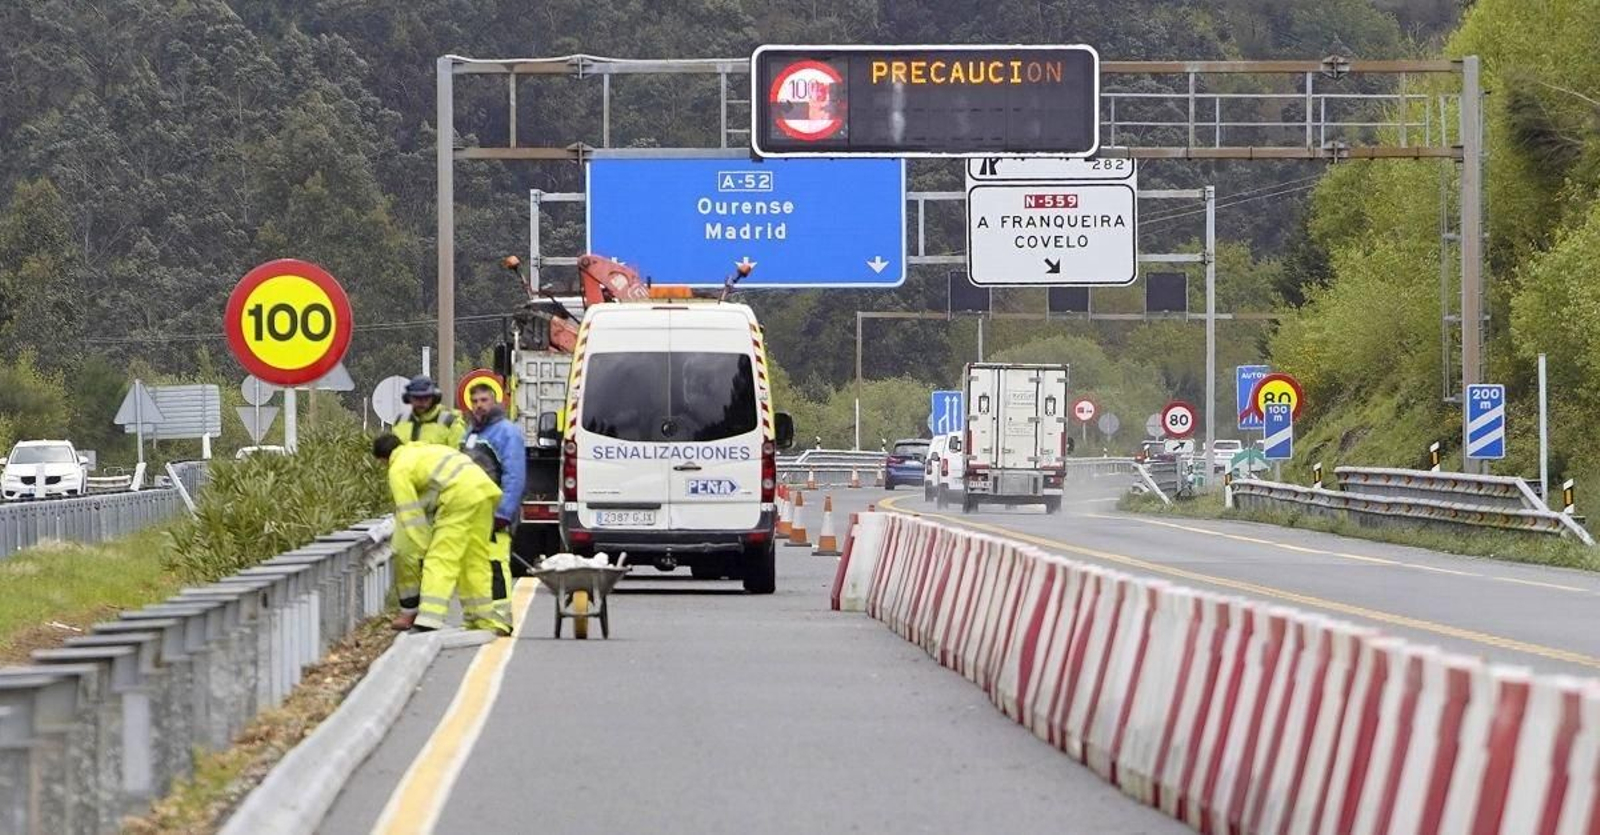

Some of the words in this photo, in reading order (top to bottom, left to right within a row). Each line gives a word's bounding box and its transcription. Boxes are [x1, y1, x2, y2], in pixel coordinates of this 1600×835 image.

[872, 61, 1062, 84] PRECAUCION
[1092, 159, 1124, 170] 282
[721, 174, 770, 189] A-52
[697, 197, 795, 215] Ourense
[1025, 195, 1077, 207] N-559
[977, 216, 989, 228] A
[1001, 215, 1126, 229] FRANQUEIRA
[705, 222, 787, 240] Madrid
[1014, 235, 1089, 249] COVELO
[247, 303, 333, 342] 100
[1473, 389, 1499, 399] 200
[1268, 405, 1288, 414] 100
[1480, 401, 1491, 409] m
[1169, 413, 1189, 426] 80
[1273, 414, 1283, 422] m
[592, 442, 751, 460] SEÑALIZACIONES
